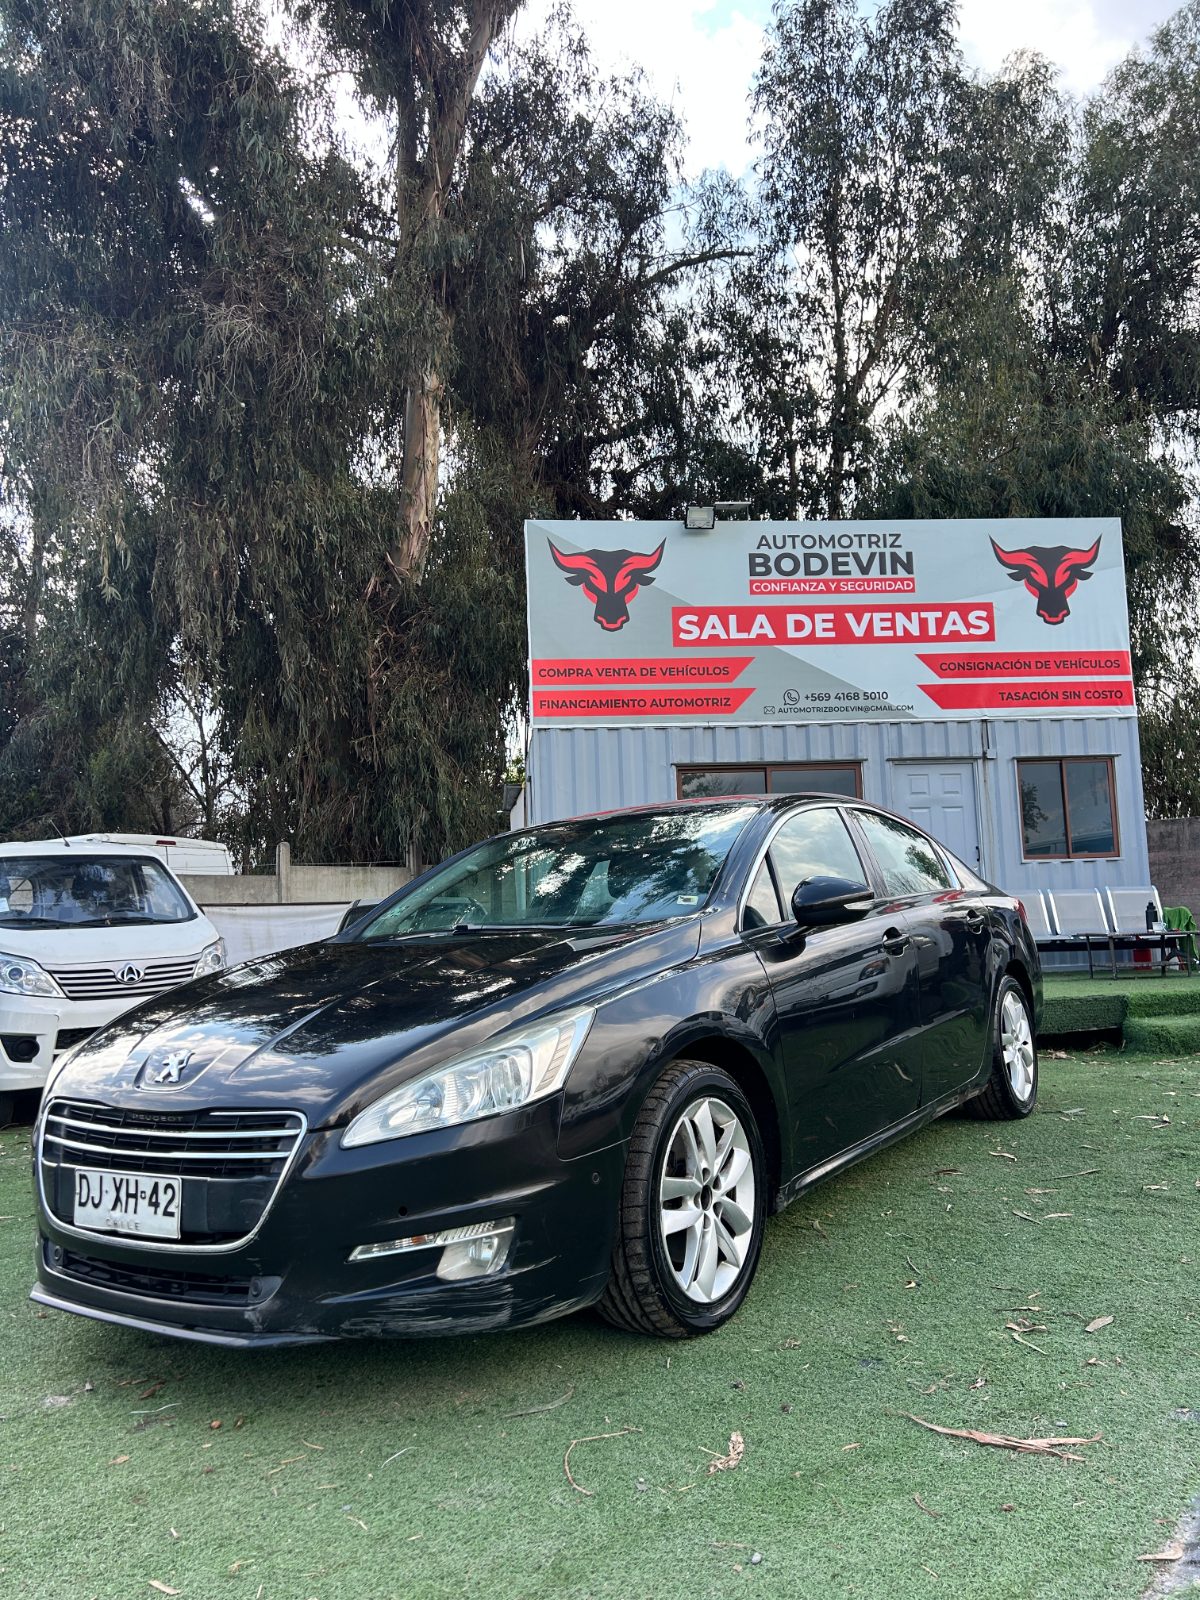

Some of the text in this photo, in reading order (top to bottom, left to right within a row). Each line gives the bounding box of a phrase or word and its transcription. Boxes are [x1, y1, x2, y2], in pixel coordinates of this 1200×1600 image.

[756, 533, 902, 550] AUTOMOTRIZ
[749, 551, 914, 577] BODEVIN
[752, 580, 914, 592] CONFIANZA Y SEGURIDAD
[678, 610, 990, 640] SALA DE VENTAS
[939, 657, 1121, 672] CONSIGNACIÓN DE VEHÍCULOS
[538, 665, 730, 678] COMPRA VENTA DE VEHÍCULOS
[804, 691, 889, 702] +569 4168 5010
[999, 689, 1123, 701] TASACIÓN SIN COSTO
[539, 697, 731, 709] FINANCIAMIENTO AUTOMOTRIZ
[778, 704, 914, 714] AUTOMOTRIZBODEVIN@GMAIL.COM
[105, 1218, 141, 1231] CHILE
